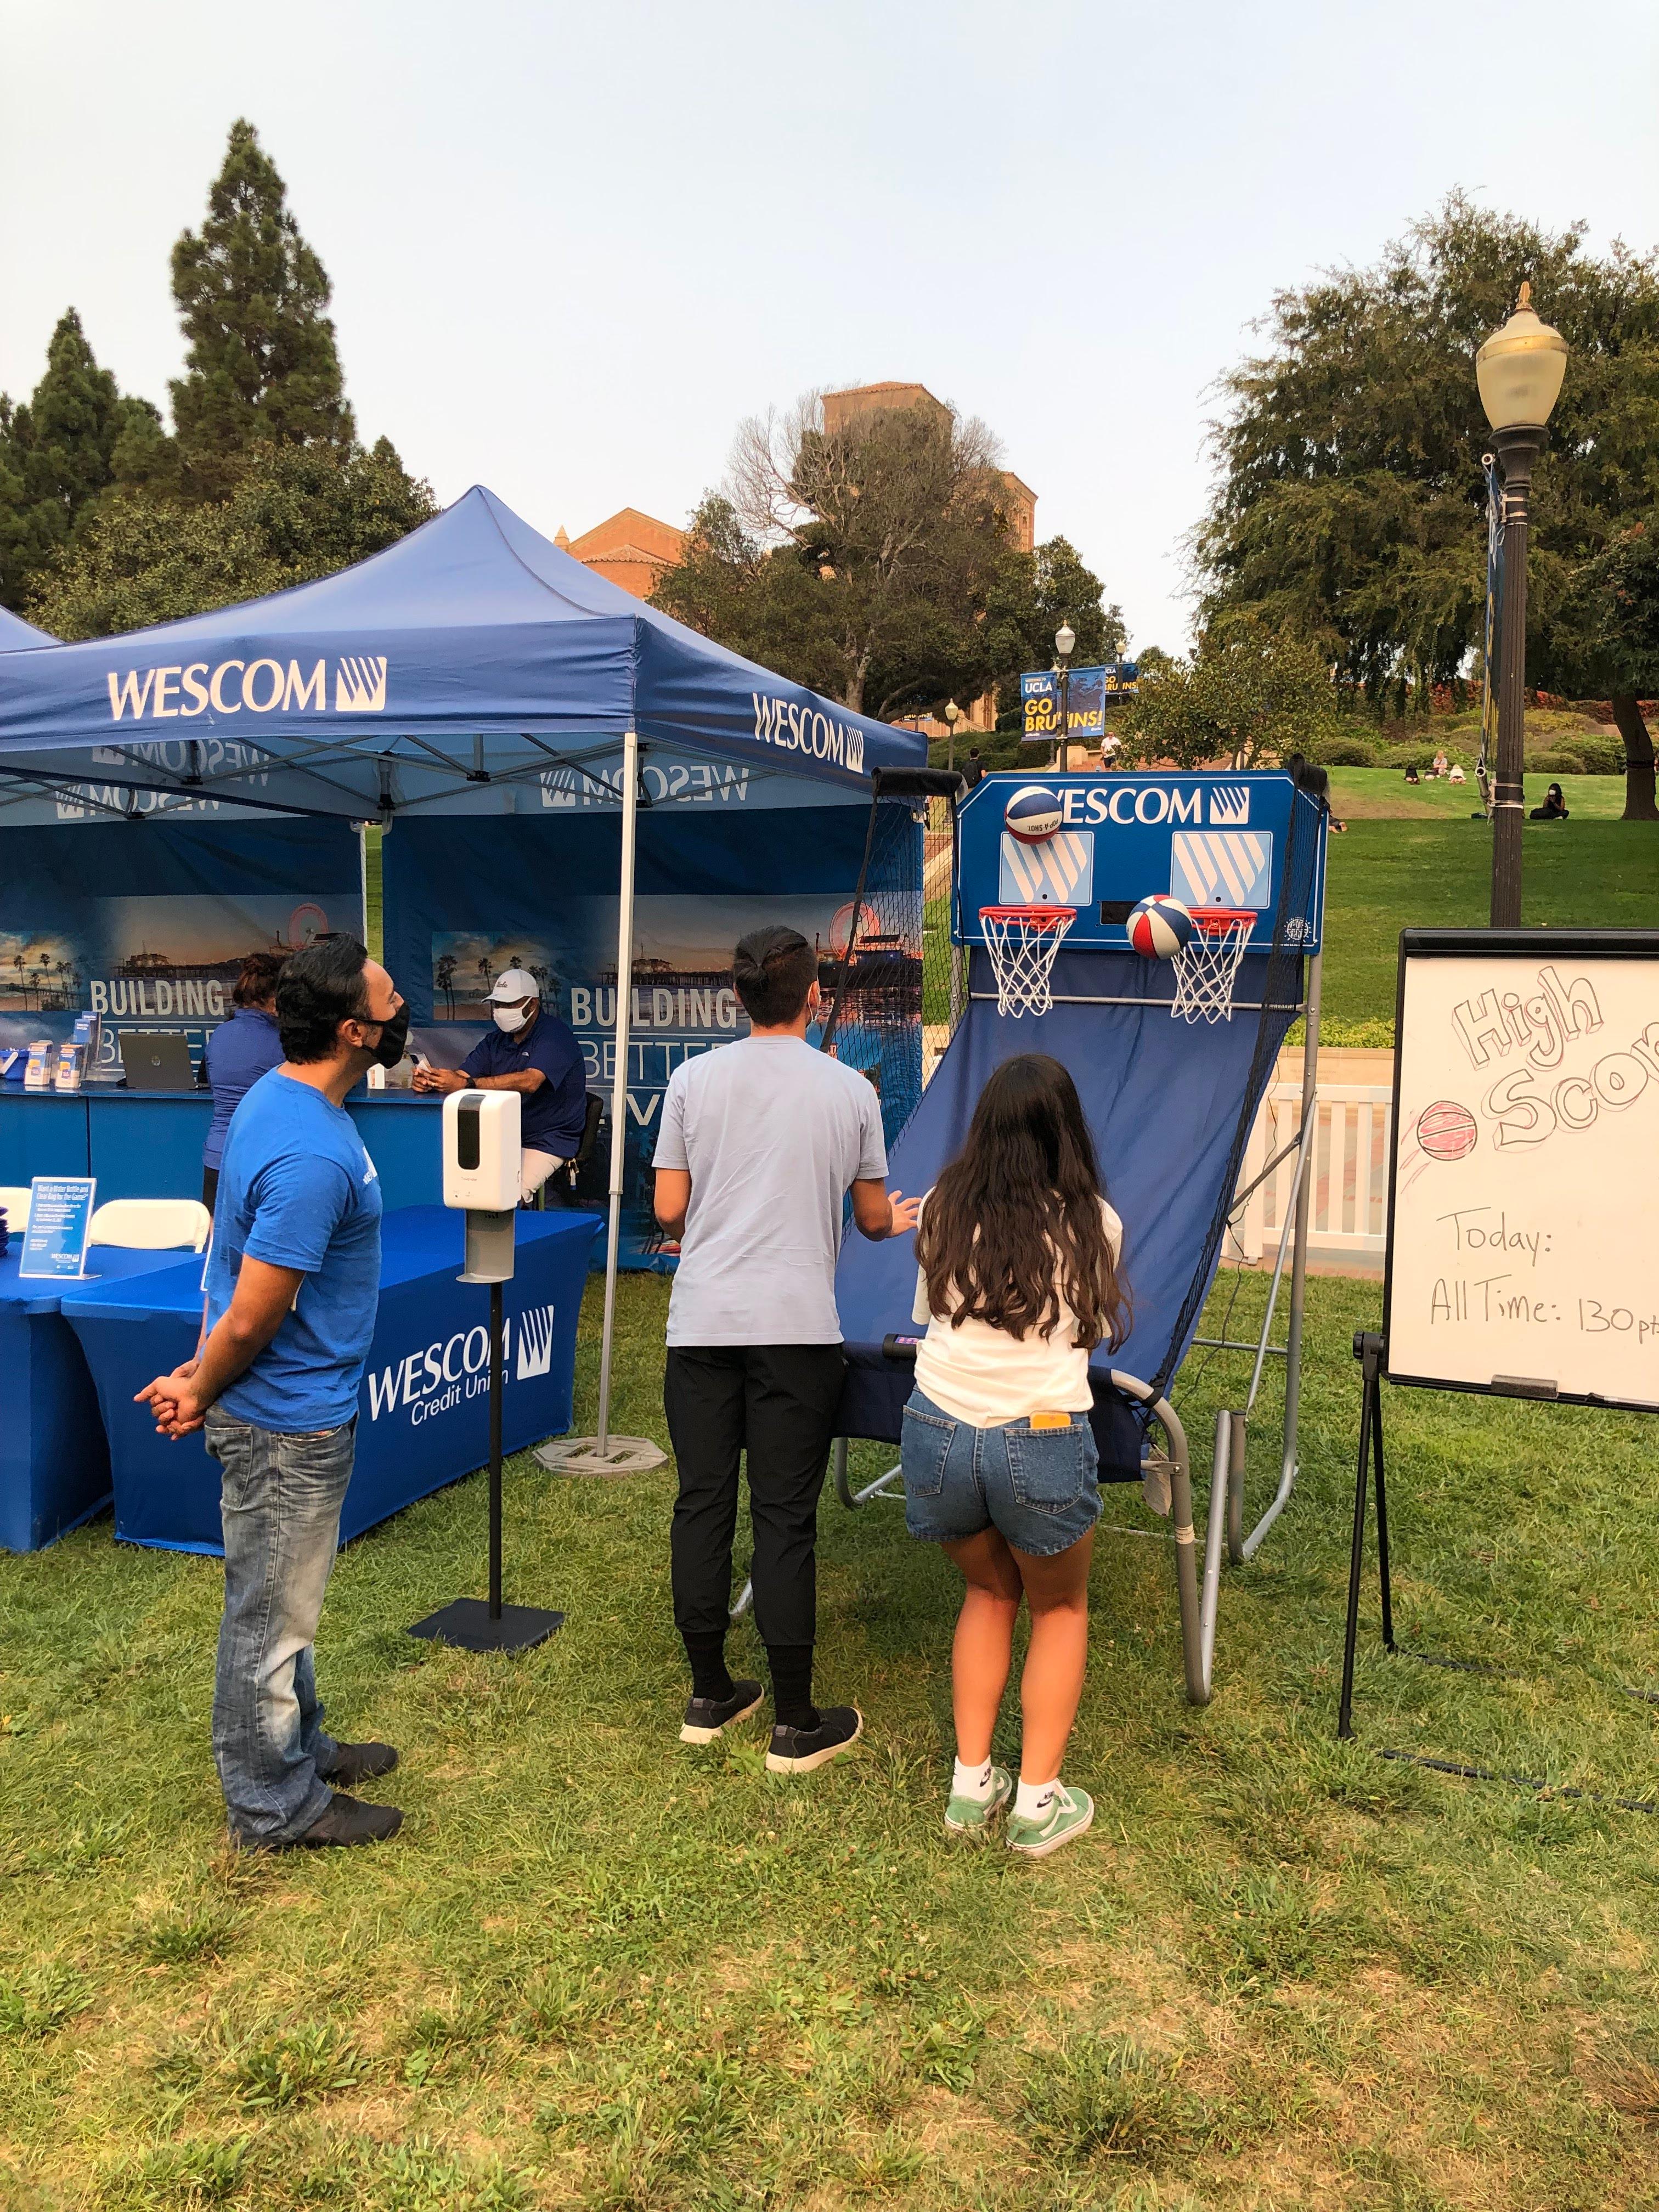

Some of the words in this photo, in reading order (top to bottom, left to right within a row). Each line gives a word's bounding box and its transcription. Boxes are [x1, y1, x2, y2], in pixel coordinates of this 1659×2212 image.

[108, 659, 326, 720] WESCOM
[1025, 681, 1053, 693] UCLA
[1025, 698, 1053, 715] GO
[753, 692, 844, 766] WESCOM
[1057, 787, 1201, 824] ESCOM
[91, 980, 225, 1015] BUILDING
[571, 988, 737, 1028] BULDING
[1452, 966, 1604, 1072] High
[1436, 1207, 1551, 1267] Today:
[411, 1385, 461, 1426] Credit
[465, 1369, 509, 1398] Unin
